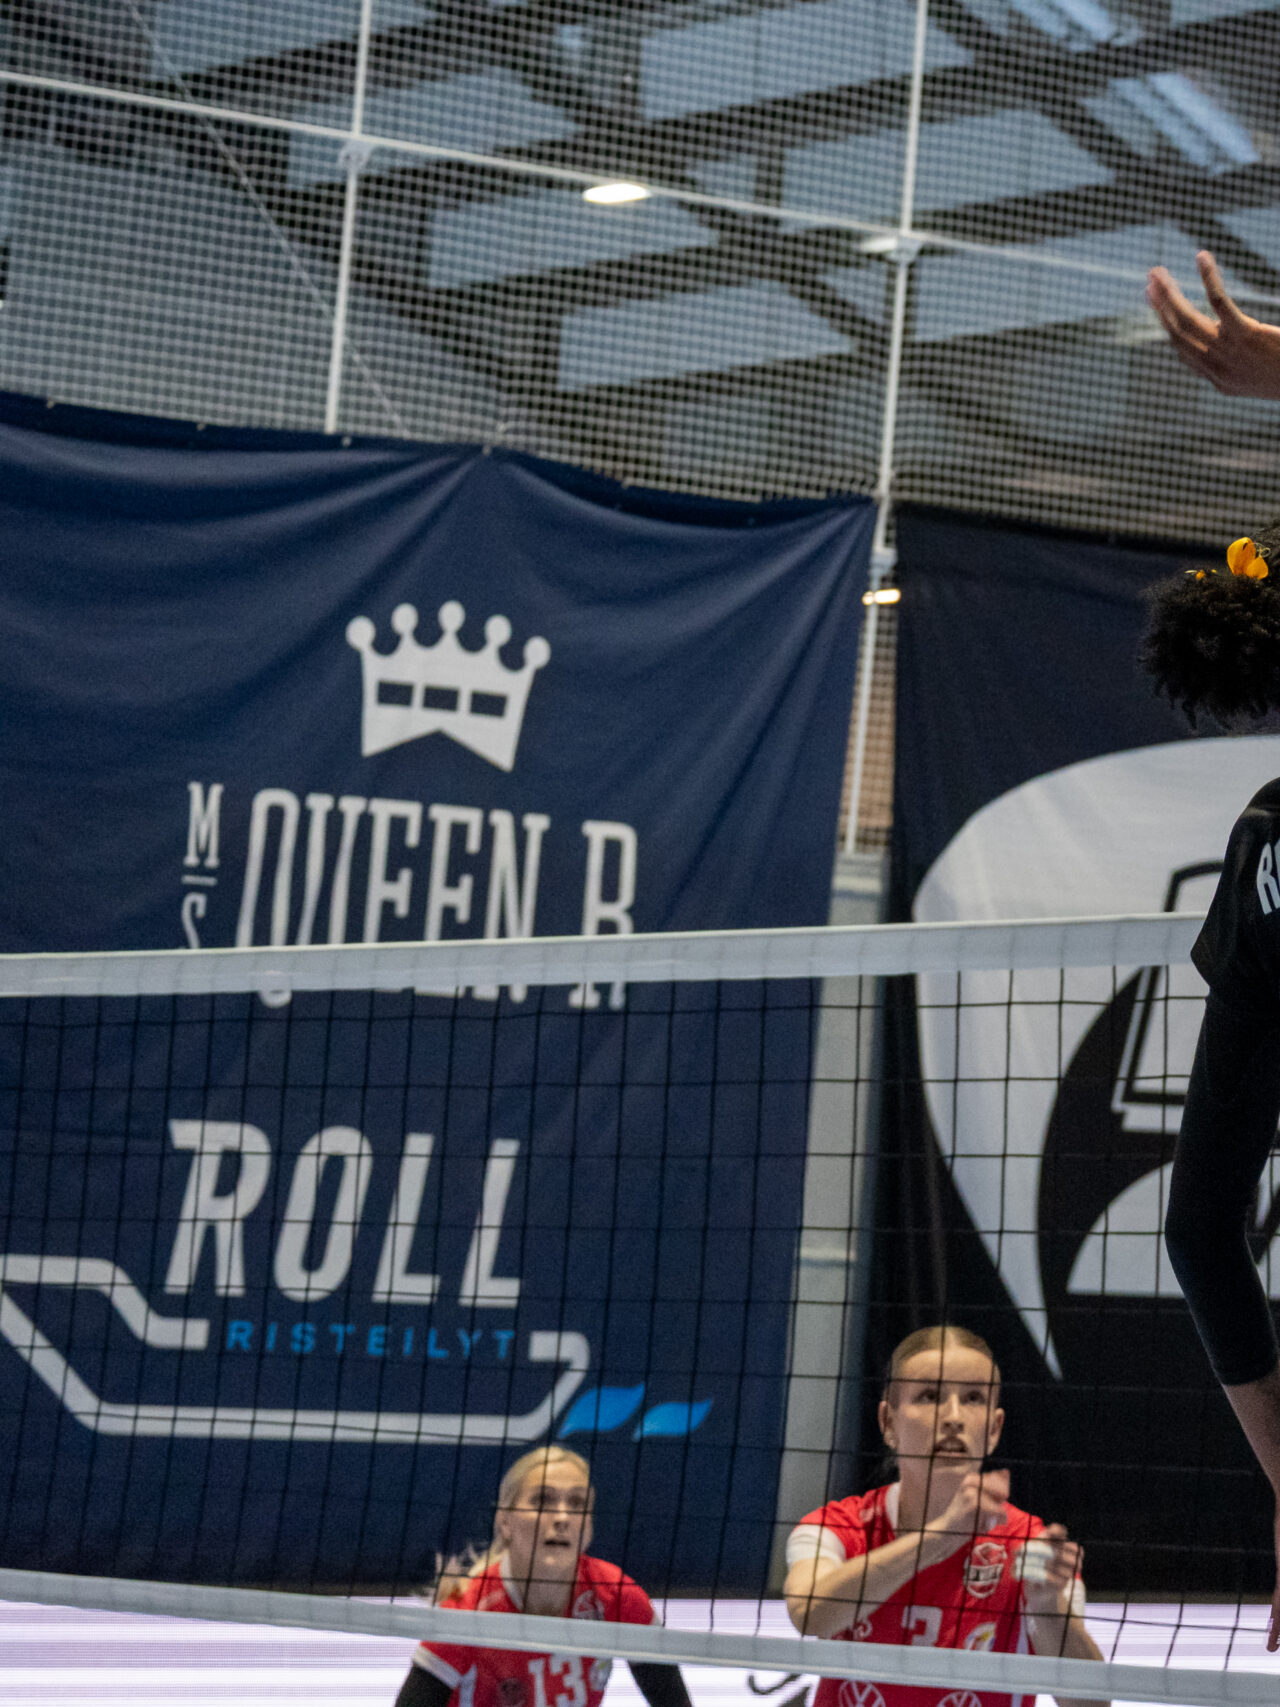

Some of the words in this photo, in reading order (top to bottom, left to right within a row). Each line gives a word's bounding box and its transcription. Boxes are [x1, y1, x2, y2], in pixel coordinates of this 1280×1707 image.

[234, 788, 551, 1008] QUEEN
[164, 1118, 521, 1309] ROLL
[226, 1320, 515, 1360] RISTEILYT
[527, 1653, 588, 1707] 13
